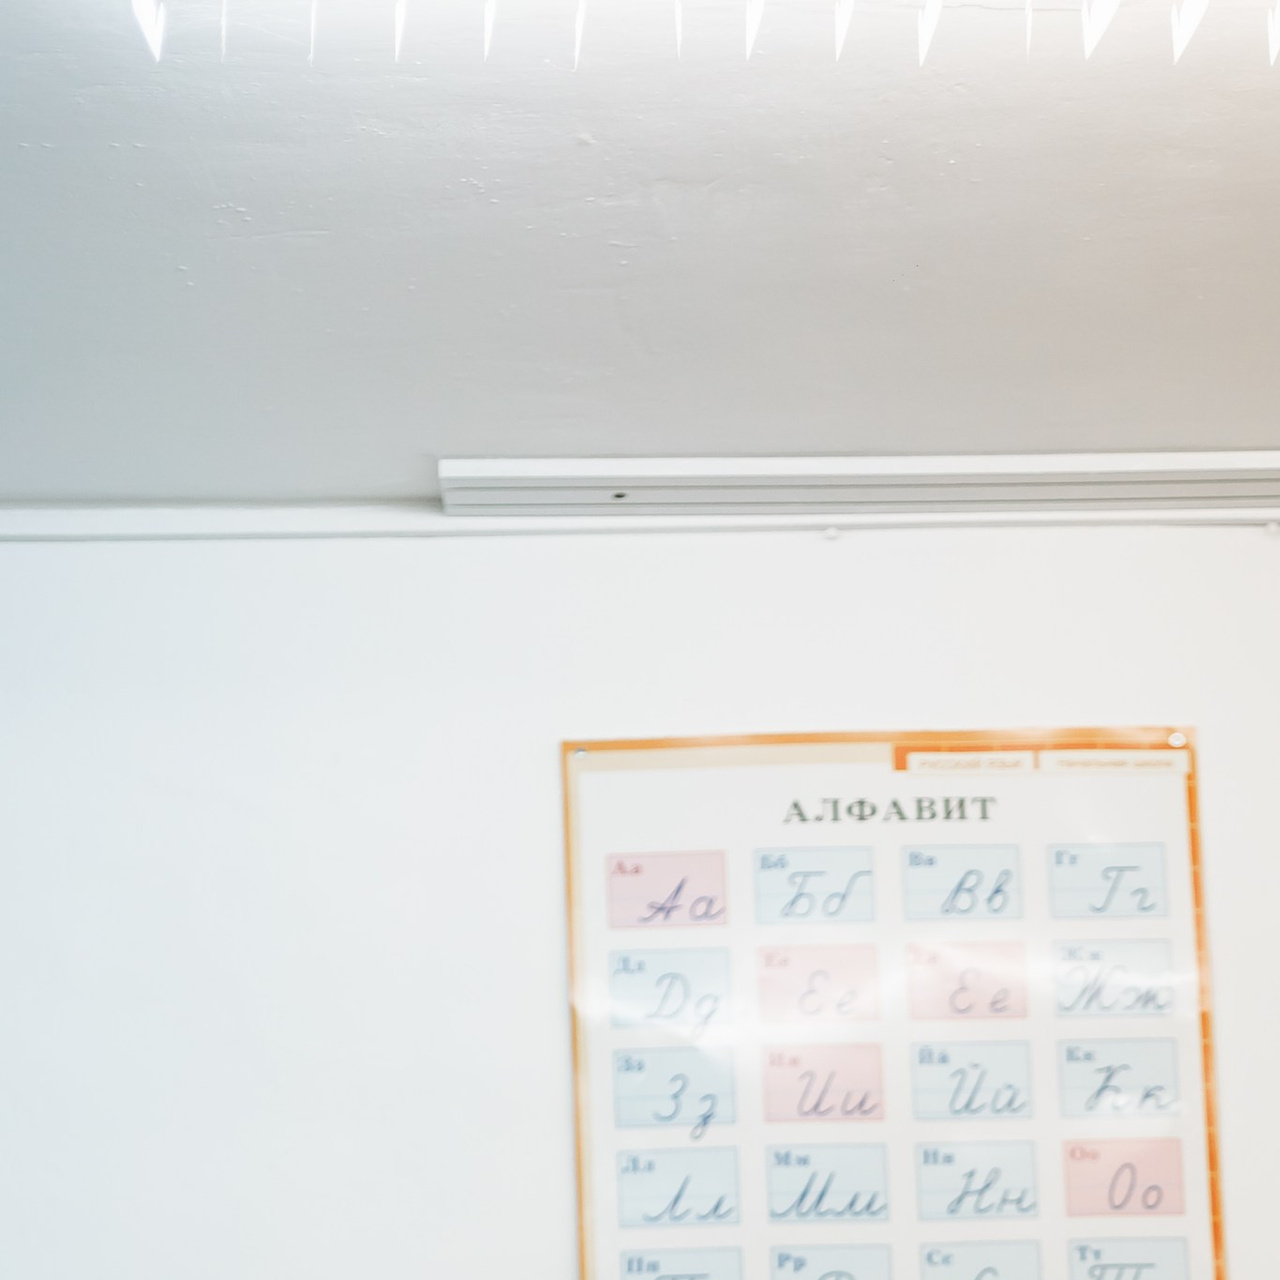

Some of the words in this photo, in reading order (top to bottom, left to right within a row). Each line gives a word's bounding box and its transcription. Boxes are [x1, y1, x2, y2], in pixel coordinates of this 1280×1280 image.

[783, 796, 997, 824] АЛФАВИТ
[637, 876, 726, 922] Аа
[780, 870, 872, 918] Бб
[941, 869, 1012, 914] Вв
[1088, 866, 1157, 913] Гг
[646, 972, 720, 1040] Дд
[653, 1073, 718, 1140] Зз
[797, 1070, 879, 1116] Ии
[949, 1063, 1027, 1115] Йй
[1085, 1064, 1177, 1112] Кк
[643, 1175, 736, 1222] Лл
[769, 1171, 887, 1218] Мм
[947, 1167, 1036, 1215] Нн
[1108, 1162, 1164, 1210] Оо
